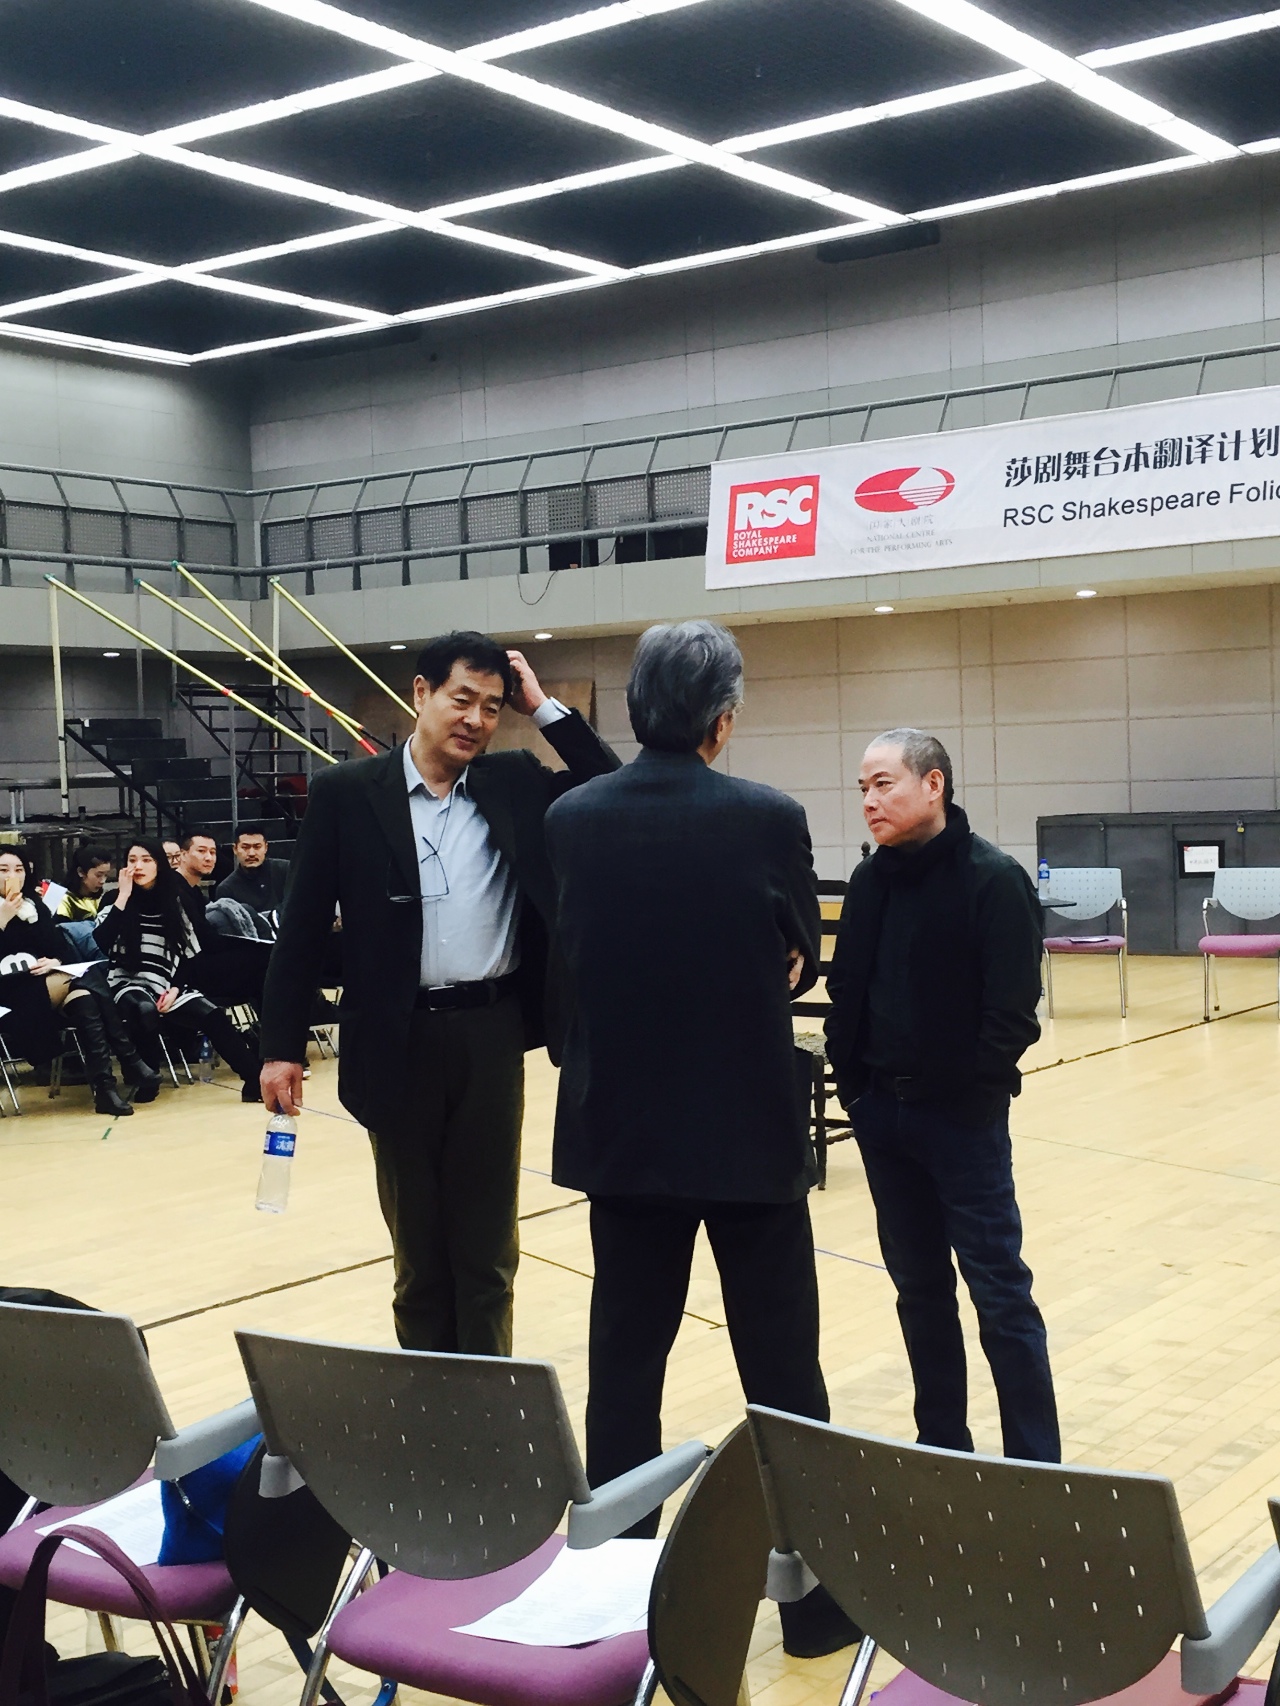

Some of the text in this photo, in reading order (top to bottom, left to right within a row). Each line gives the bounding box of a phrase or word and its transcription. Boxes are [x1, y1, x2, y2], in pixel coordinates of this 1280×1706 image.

[1005, 425, 1280, 487] 莎剧舞台本翻译计划
[735, 484, 813, 530] RSC
[1003, 504, 1054, 527] RSC
[1062, 490, 1221, 521] Shakespeare
[733, 530, 762, 541] ROYAL
[733, 534, 797, 550] SHAKESPEARE
[867, 529, 935, 543] NATIONAL CENTRE
[732, 545, 779, 558] COMPANY
[850, 538, 953, 555] FOR THE PERFORMING ARTS
